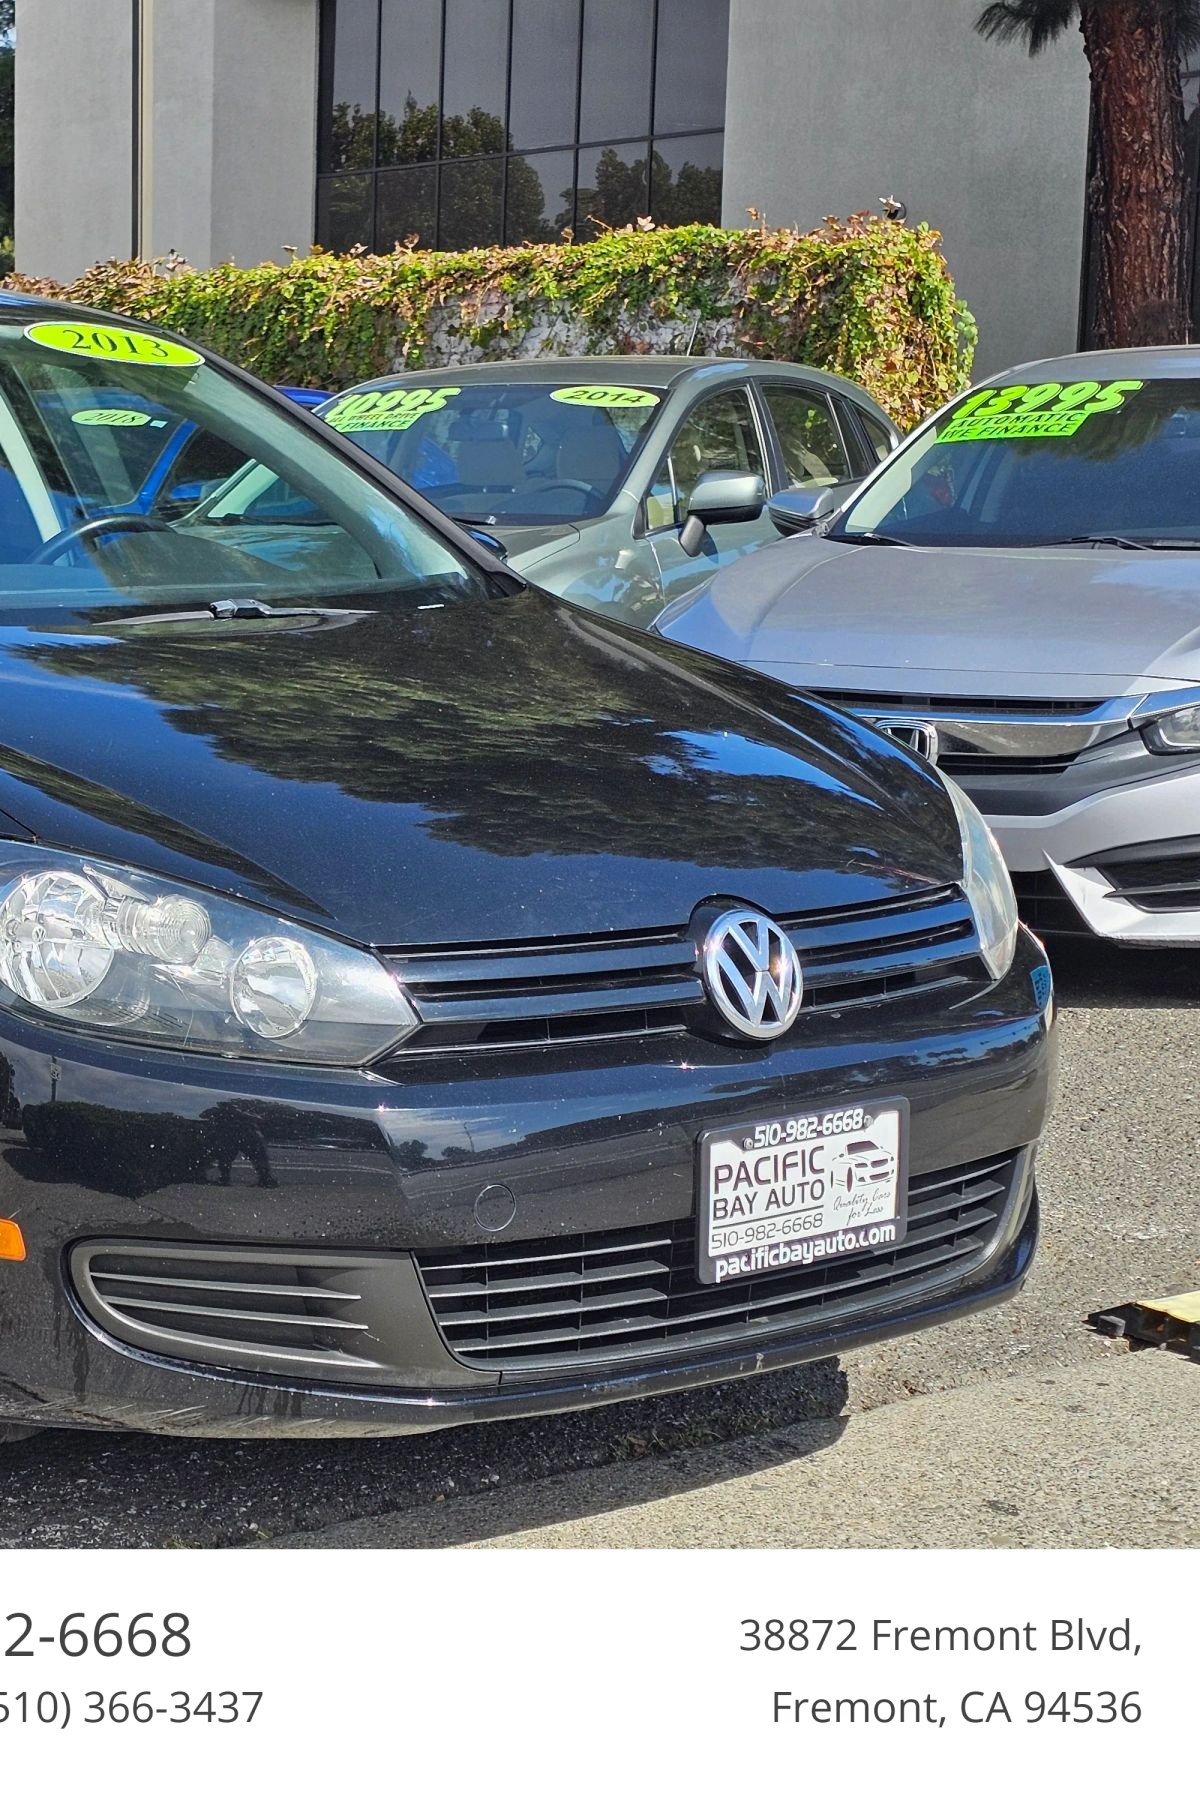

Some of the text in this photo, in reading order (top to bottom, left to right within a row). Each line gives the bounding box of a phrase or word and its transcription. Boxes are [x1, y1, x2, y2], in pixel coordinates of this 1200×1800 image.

[61, 328, 170, 358] 2013
[325, 387, 461, 416] 10995
[573, 389, 644, 404] 2014
[952, 380, 1144, 419] 13995
[83, 411, 139, 424] 2018
[341, 420, 412, 431] FINANCE
[384, 412, 420, 420] DRIVE
[941, 422, 1071, 440] WE FINANCE
[951, 411, 1084, 429] AUTOMATIC
[710, 914, 799, 1032] VW
[753, 1107, 864, 1149] 510-982-6668
[713, 1145, 826, 1195] PACIFIC
[712, 1178, 825, 1221] BAY AUTO
[711, 1212, 824, 1250] 510-982-6668
[715, 1223, 896, 1284] pacificbayauto.com
